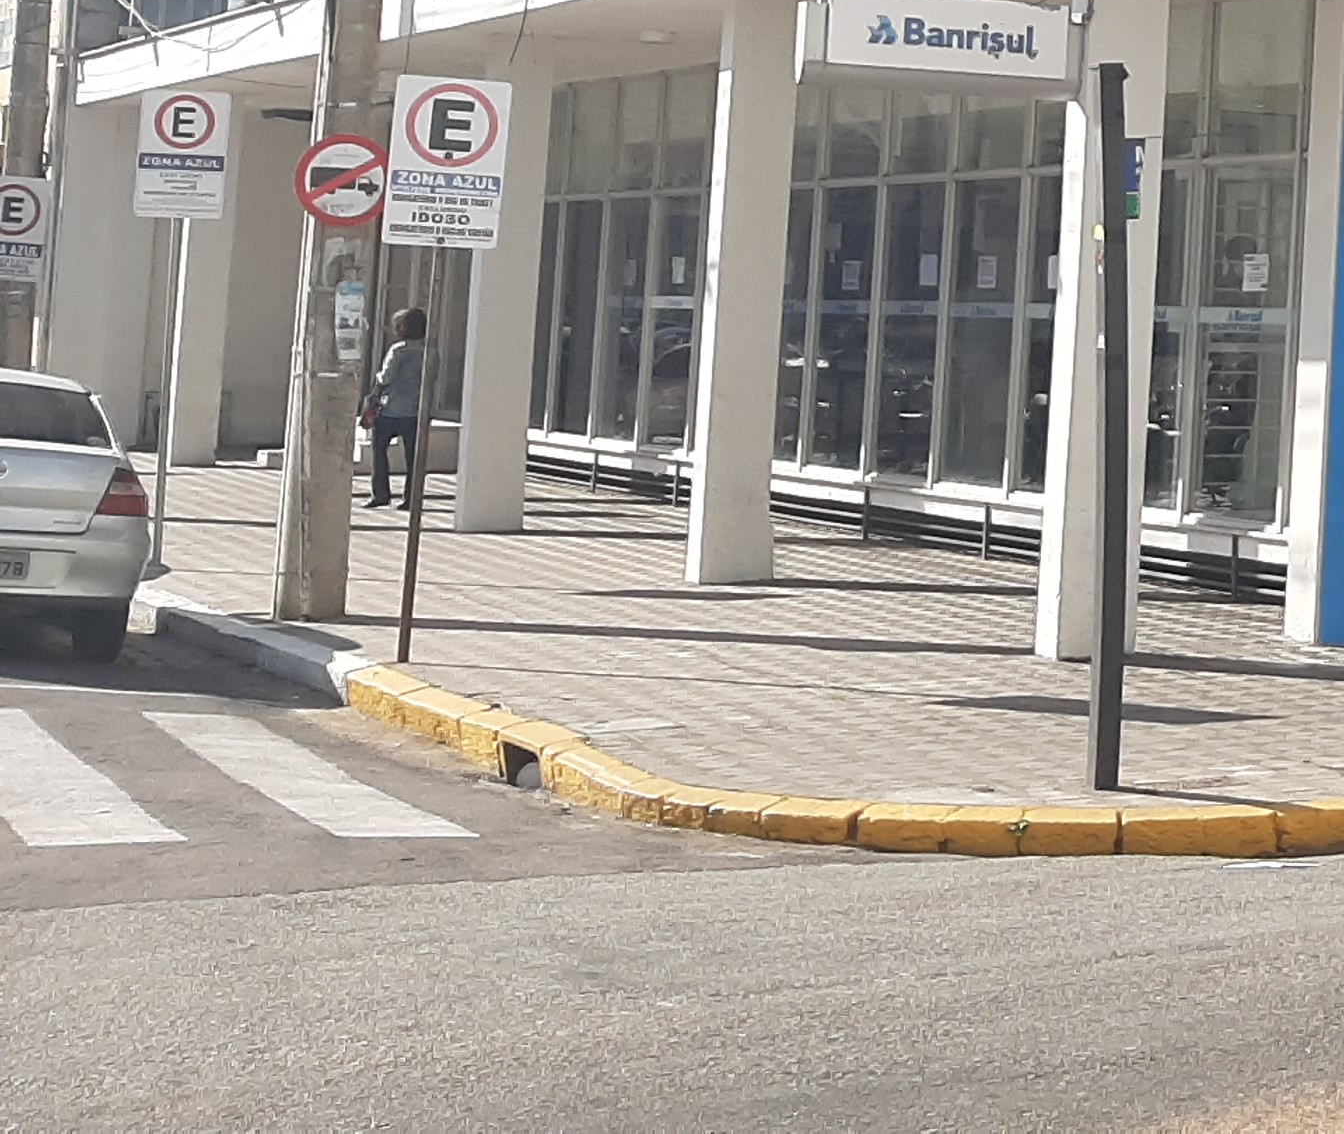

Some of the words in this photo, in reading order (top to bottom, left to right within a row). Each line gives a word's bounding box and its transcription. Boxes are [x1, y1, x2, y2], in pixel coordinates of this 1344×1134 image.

[903, 17, 1036, 56] Banrisul
[172, 107, 197, 138] E
[429, 98, 475, 153] E
[397, 171, 446, 187] ZONA
[452, 177, 498, 191] AZUL
[1, 196, 24, 223] E
